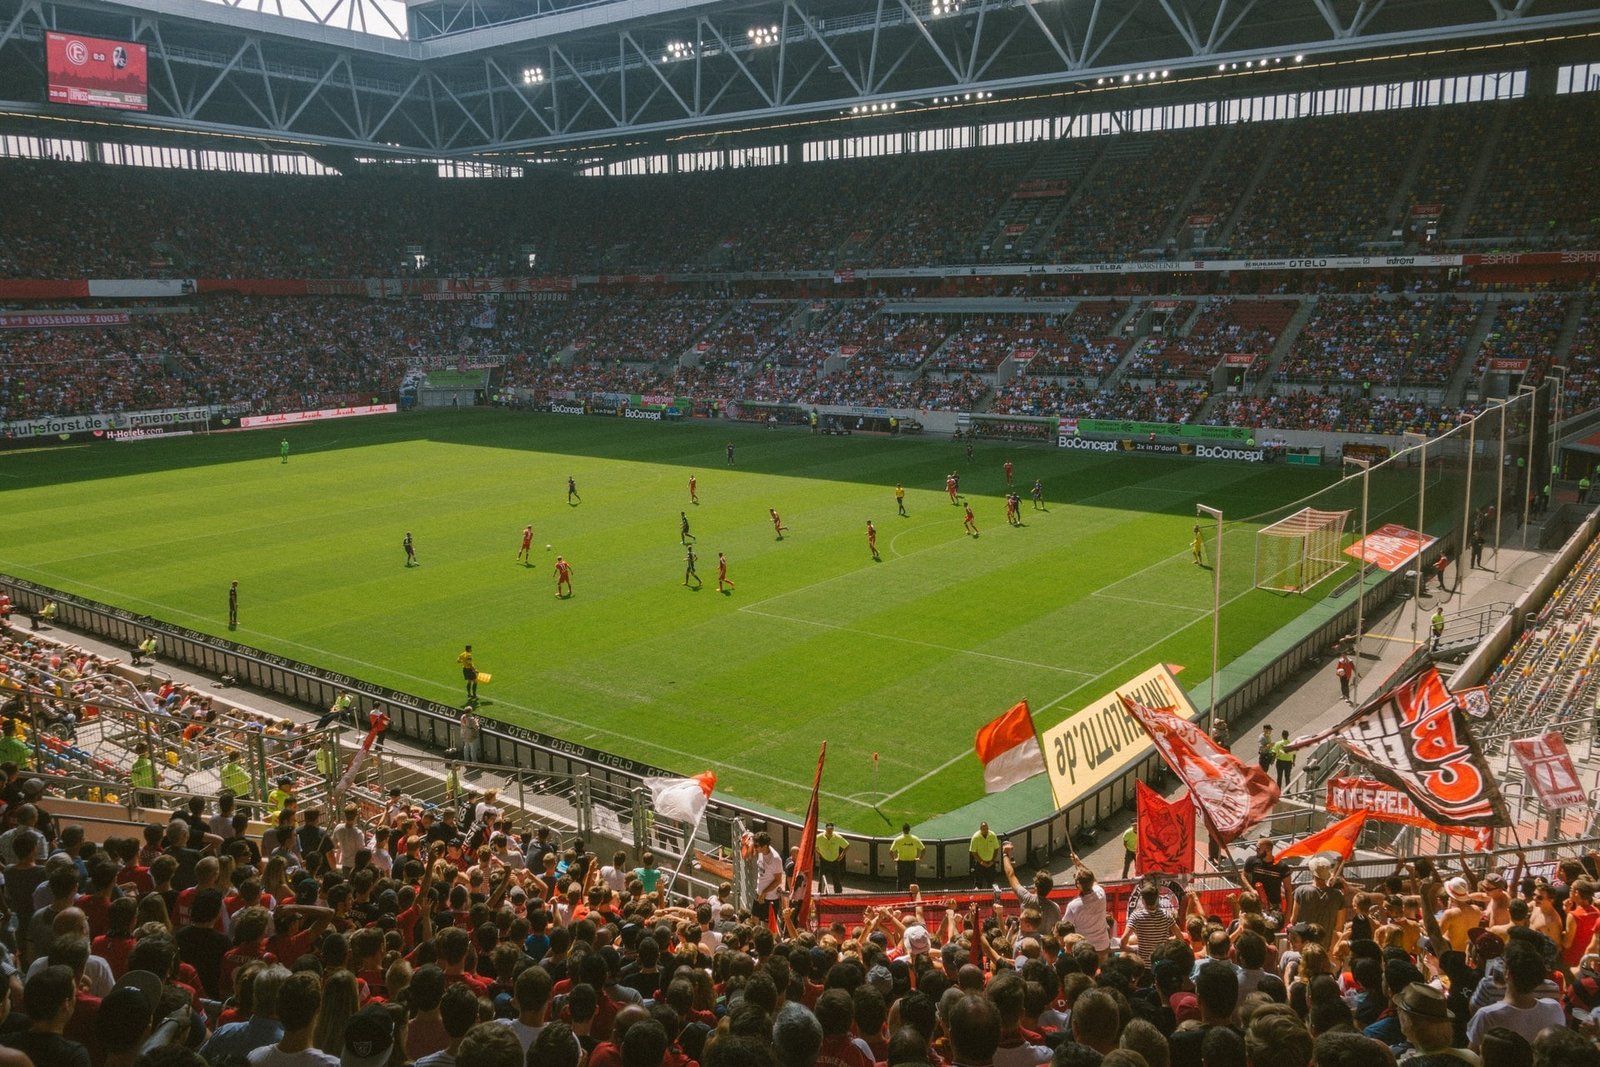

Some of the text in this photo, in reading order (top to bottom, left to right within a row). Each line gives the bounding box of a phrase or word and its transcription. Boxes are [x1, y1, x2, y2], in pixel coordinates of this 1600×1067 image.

[1136, 261, 1181, 270] WARSTEINER
[1481, 254, 1520, 265] ESPRIT
[95, 314, 120, 323] 2003
[551, 404, 585, 415] BoConcept
[625, 408, 661, 421] BoConcept
[107, 428, 163, 441] H-Hotels.com
[1058, 437, 1118, 453] BoConcept
[1196, 446, 1265, 463] BoConcept
